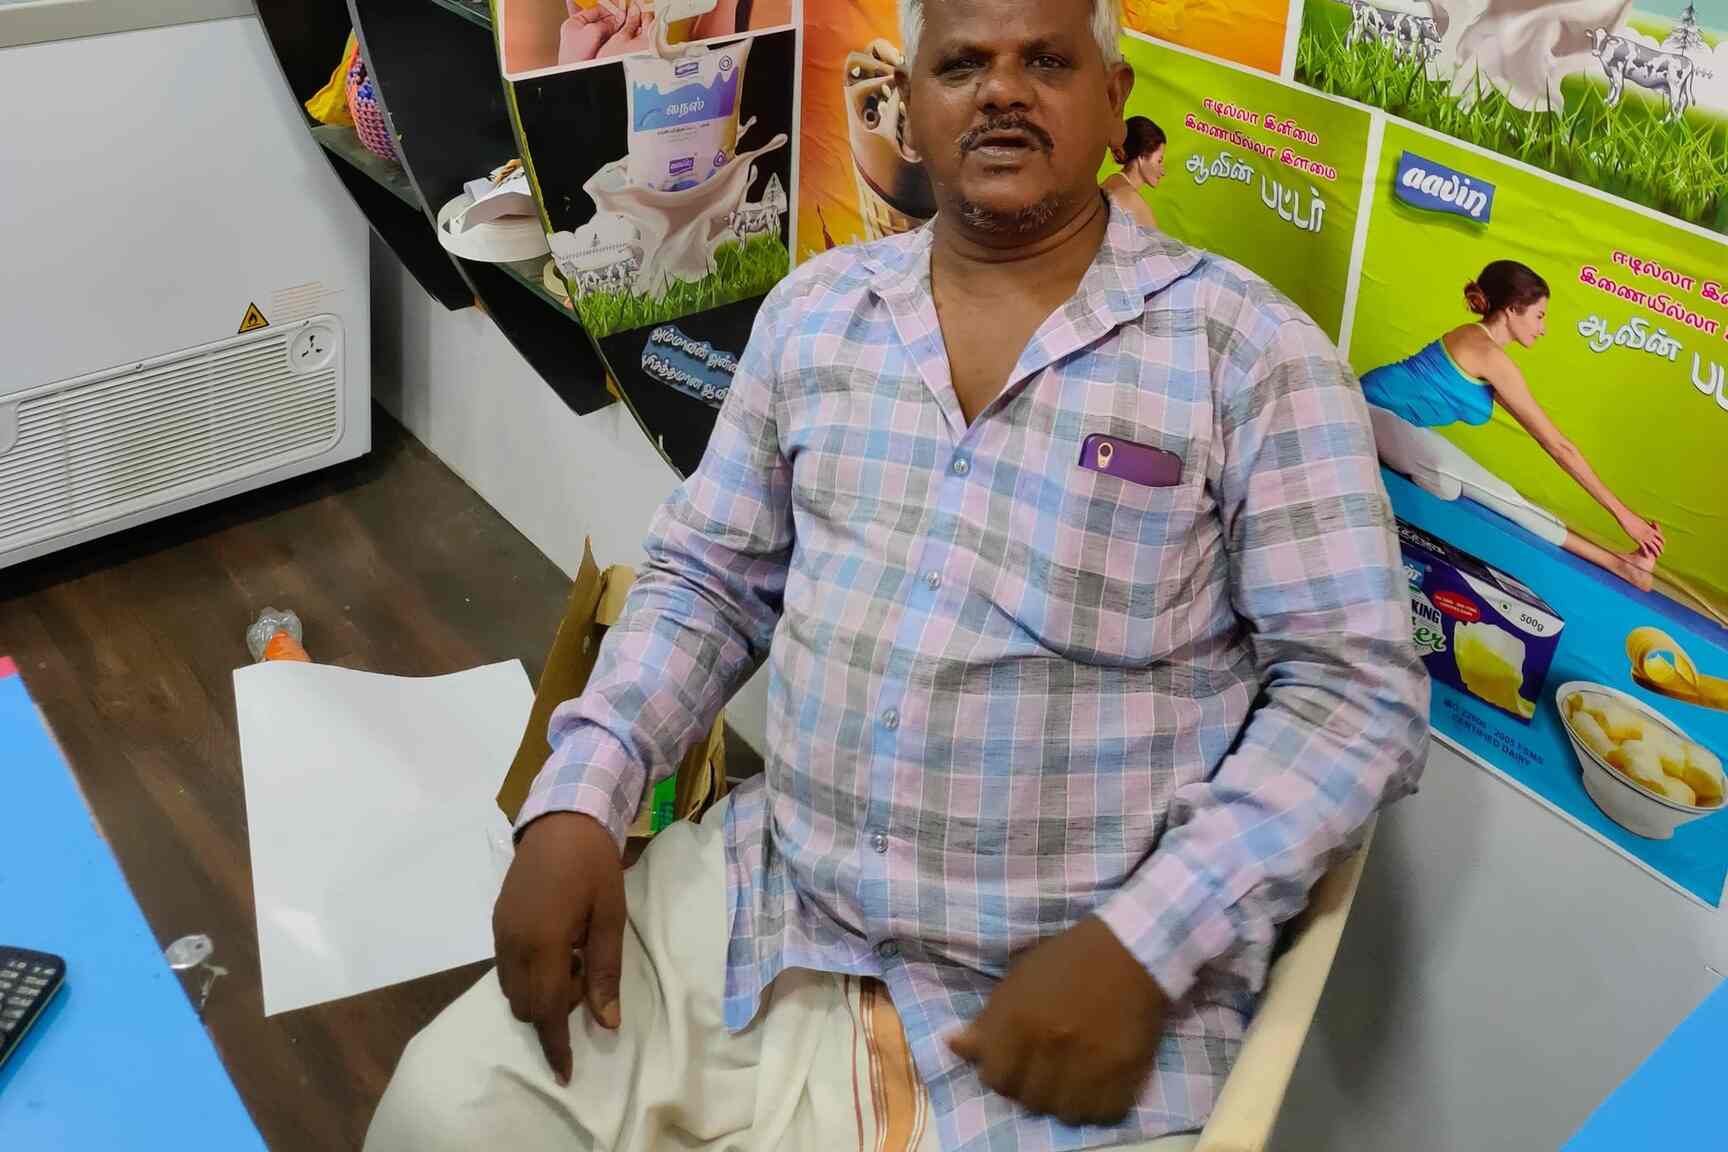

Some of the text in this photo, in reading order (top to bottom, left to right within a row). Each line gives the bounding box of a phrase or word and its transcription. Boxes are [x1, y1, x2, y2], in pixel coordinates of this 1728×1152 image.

[1202, 96, 1319, 145] ஈடில்லா இனிமை
[1185, 152, 1326, 234] ஆவின் பட்டர்
[1402, 166, 1488, 218] aavin
[1612, 249, 1696, 291] ஈடில்லா
[1580, 265, 1720, 335] இணையில்லா
[1577, 313, 1682, 362] ஆவின்
[1411, 599, 1441, 625] KING
[1519, 613, 1545, 633] 500g
